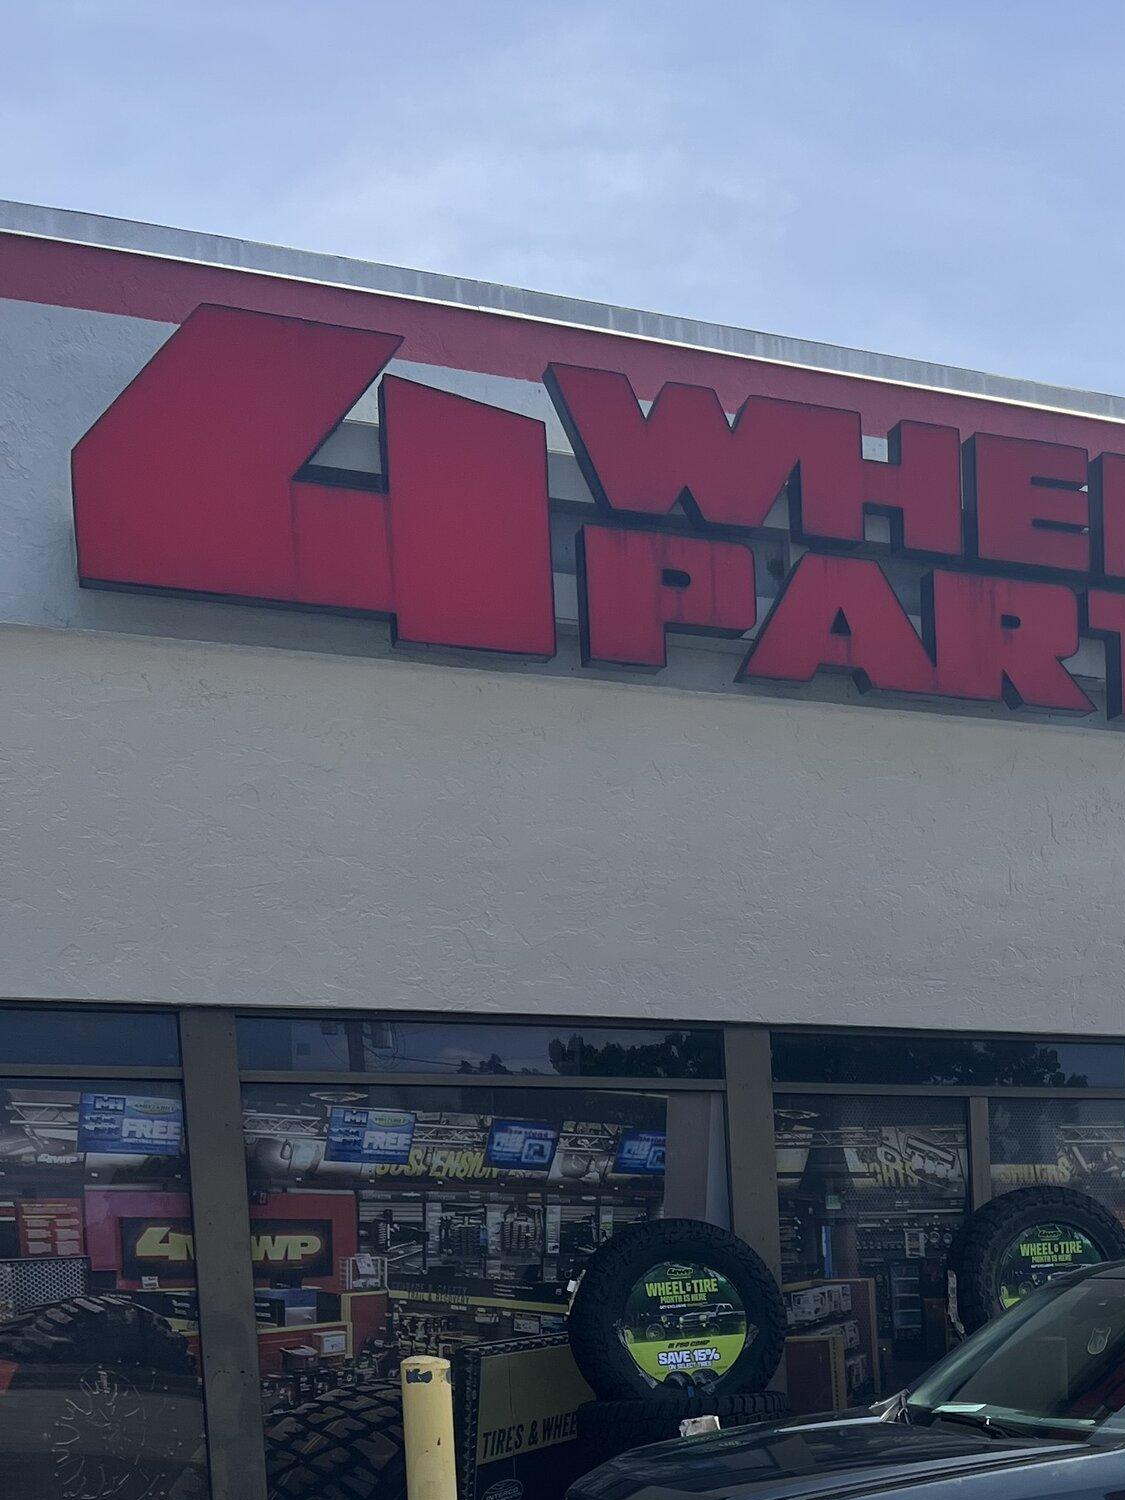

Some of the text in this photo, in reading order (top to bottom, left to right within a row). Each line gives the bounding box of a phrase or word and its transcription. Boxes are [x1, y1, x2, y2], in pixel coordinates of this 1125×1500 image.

[71, 303, 556, 662] 4
[122, 1118, 182, 1140] FREE
[362, 1130, 413, 1151] FREE
[1020, 1242, 1054, 1257] WHEEL
[1059, 1240, 1083, 1254] TIRE
[645, 1281, 686, 1298] WHEEL
[691, 1278, 719, 1294] TIRE
[660, 1293, 707, 1304] MONTH IS HERE
[658, 1348, 721, 1365] SAVE 15%
[483, 1423, 525, 1459] TIRES
[528, 1420, 539, 1446] &
